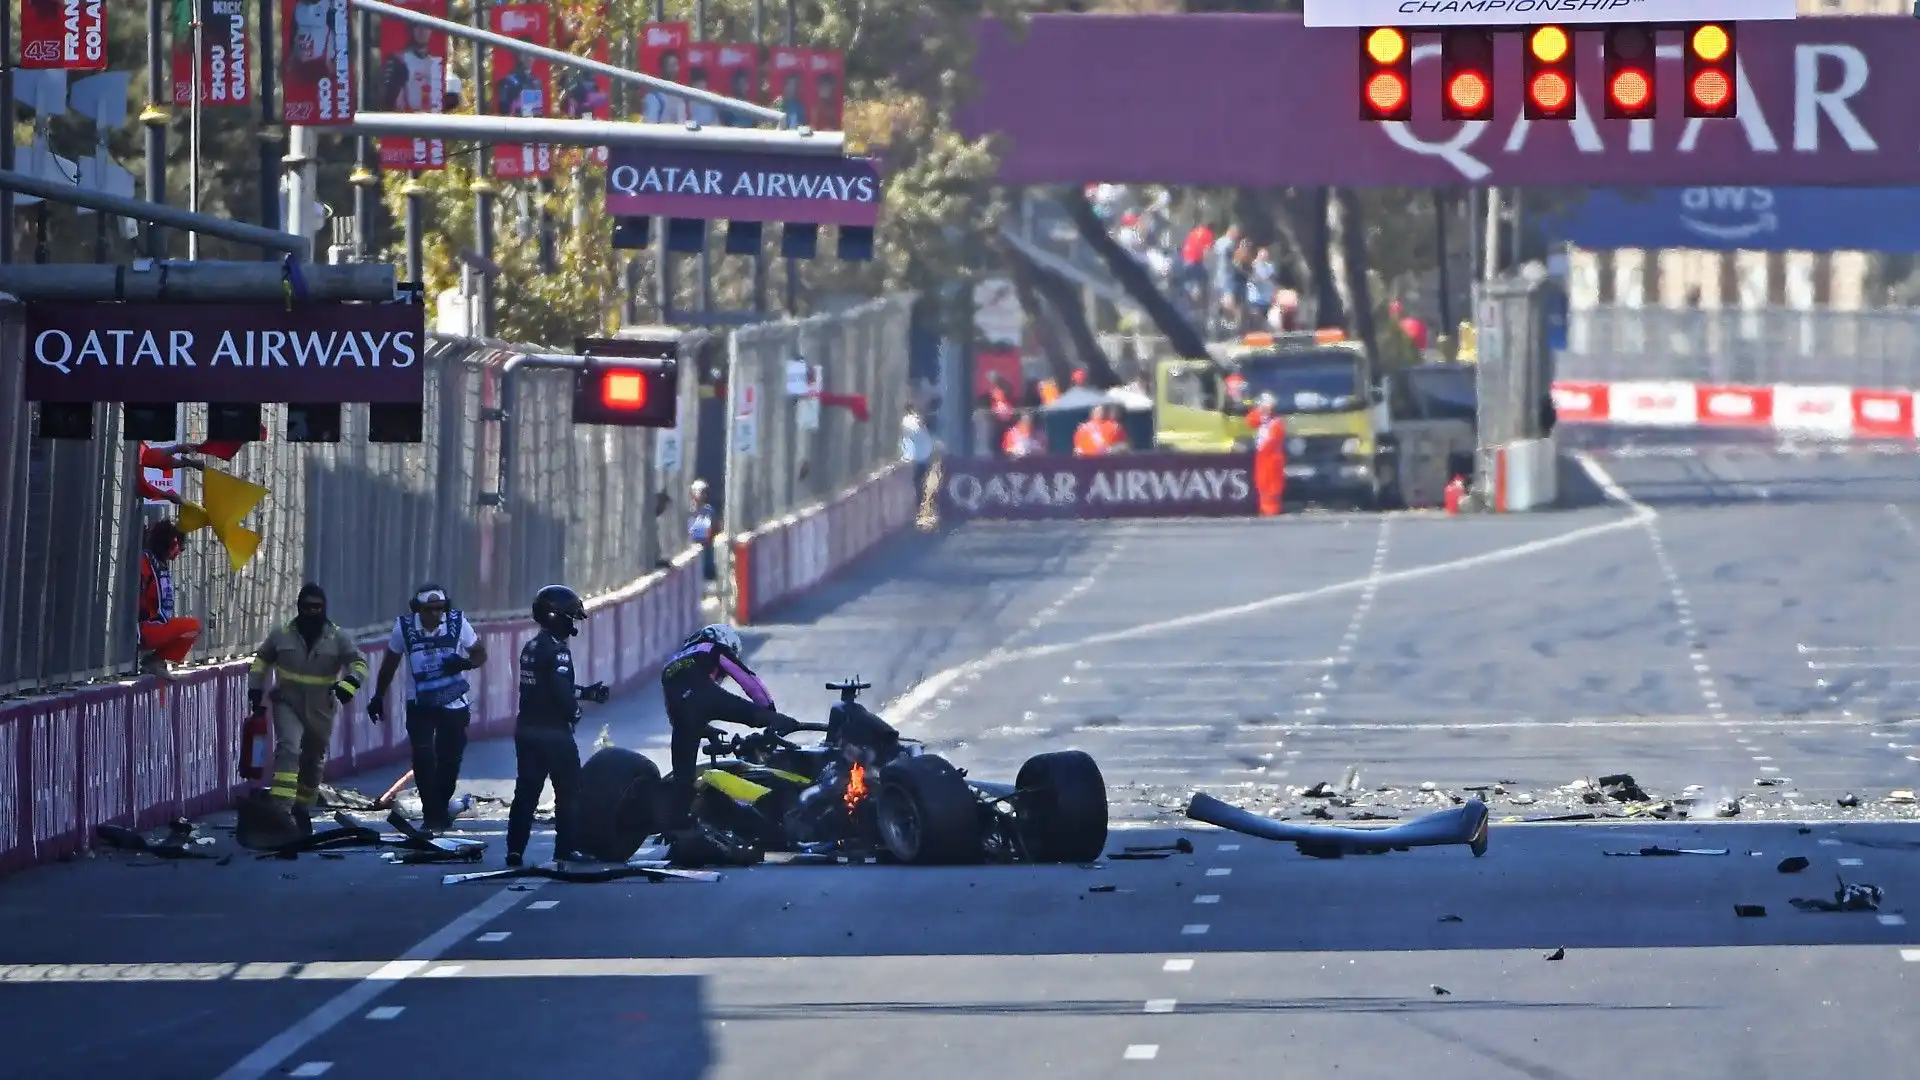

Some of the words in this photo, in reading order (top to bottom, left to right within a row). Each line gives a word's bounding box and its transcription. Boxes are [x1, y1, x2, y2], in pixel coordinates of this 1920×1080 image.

[25, 40, 60, 61] 43
[86, 0, 101, 61] COLA
[212, 45, 226, 101] ZHOU
[231, 14, 245, 100] GUANYU
[319, 77, 333, 120] NICO
[611, 164, 723, 197] QATAR
[732, 170, 874, 203] AIRWAYS
[34, 328, 197, 374] QATAR
[210, 330, 416, 369] AIRWAYS
[949, 472, 1077, 511] QATAR
[1085, 468, 1249, 502] AIRWAYS
